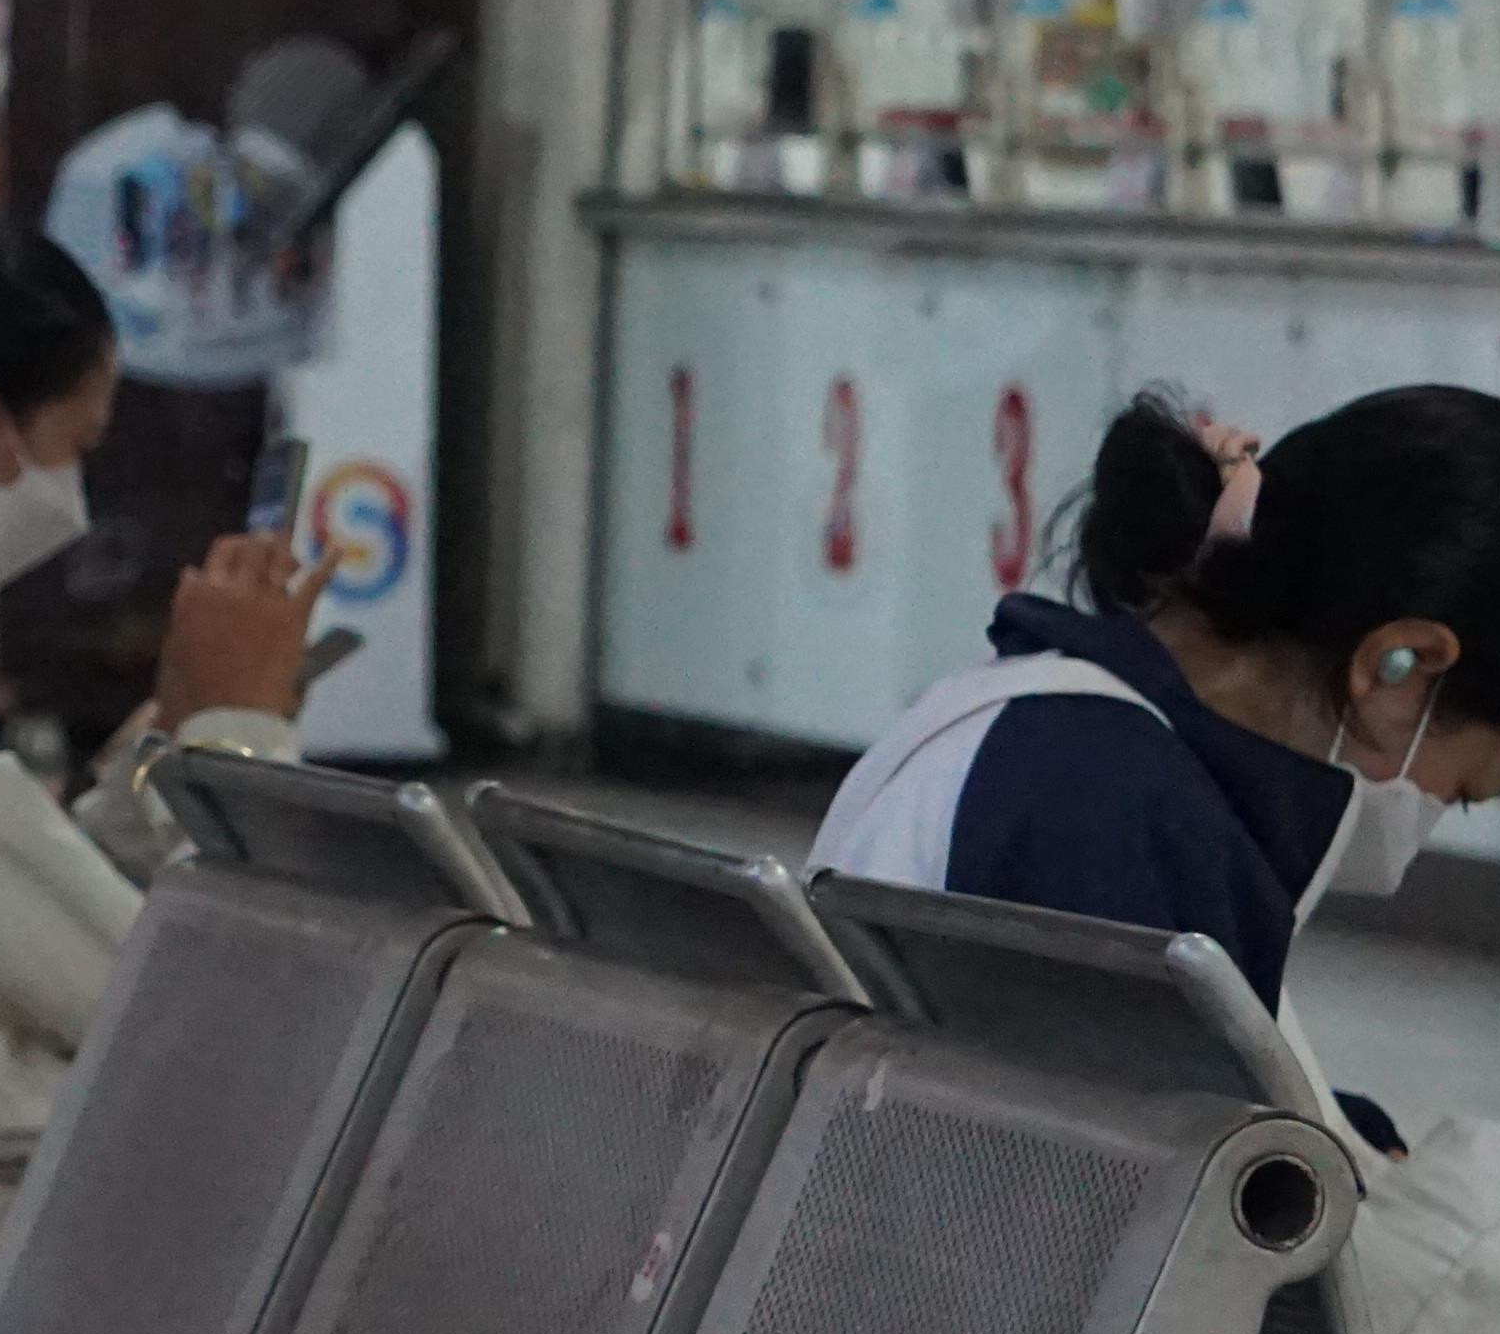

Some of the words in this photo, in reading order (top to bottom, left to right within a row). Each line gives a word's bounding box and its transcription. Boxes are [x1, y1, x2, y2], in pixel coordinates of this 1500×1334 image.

[665, 363, 696, 554] 1
[822, 376, 863, 572] 2
[994, 383, 1034, 591] 3
